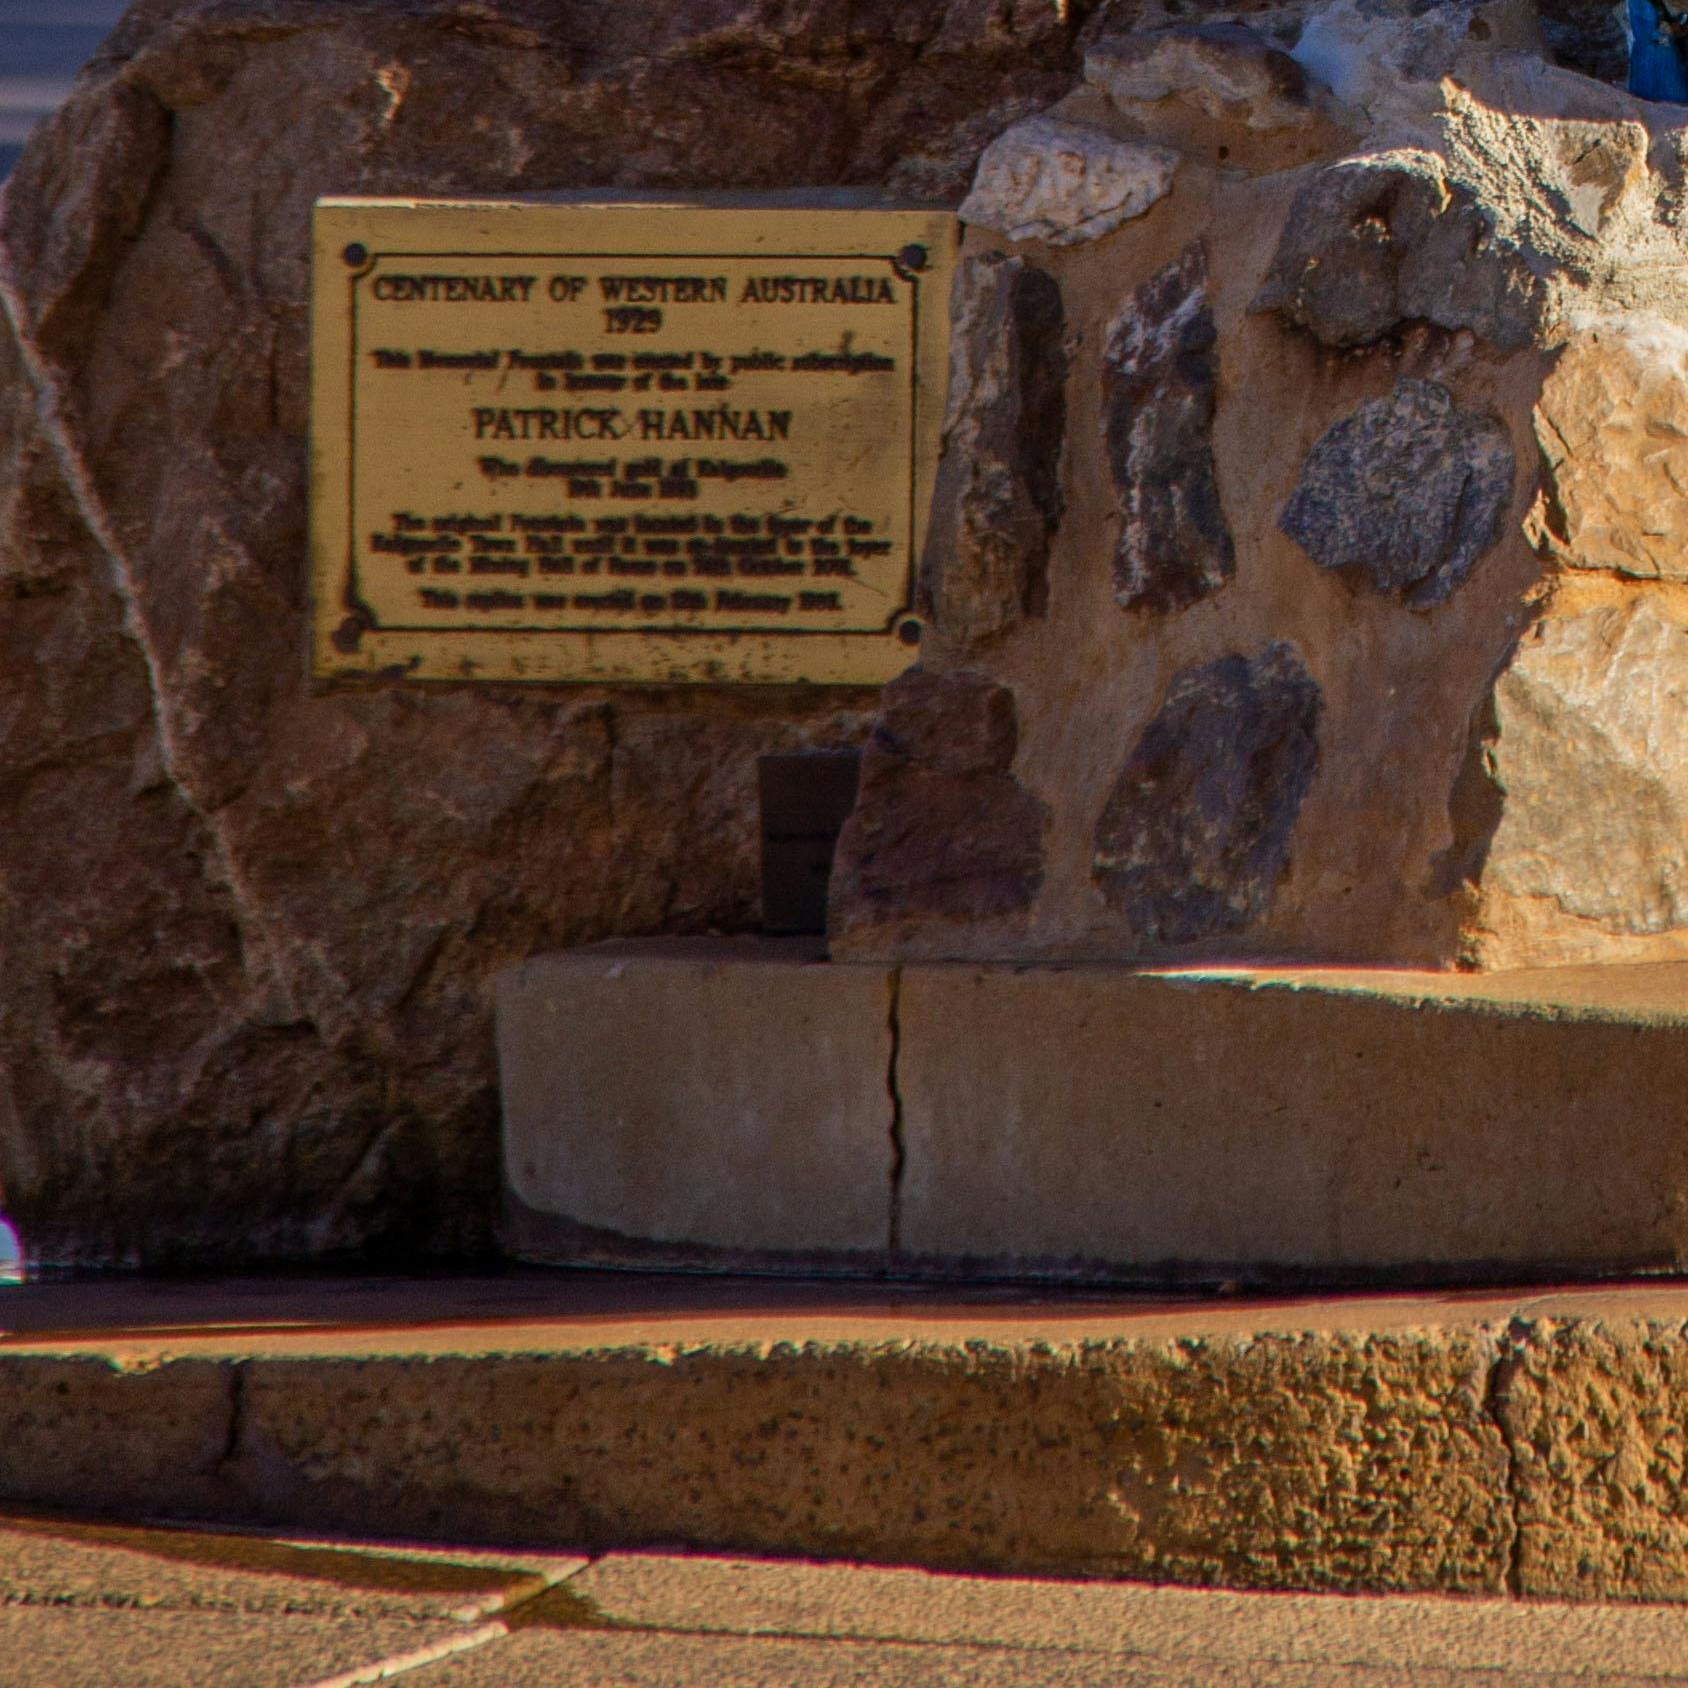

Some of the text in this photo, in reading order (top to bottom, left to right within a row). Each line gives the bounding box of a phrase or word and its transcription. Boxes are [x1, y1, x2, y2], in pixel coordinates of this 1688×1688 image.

[372, 273, 897, 304] CENTENARY OF WESTERN AUSTRALIA
[604, 304, 662, 334] 1929
[471, 406, 793, 441] PATRICK HANNAN
